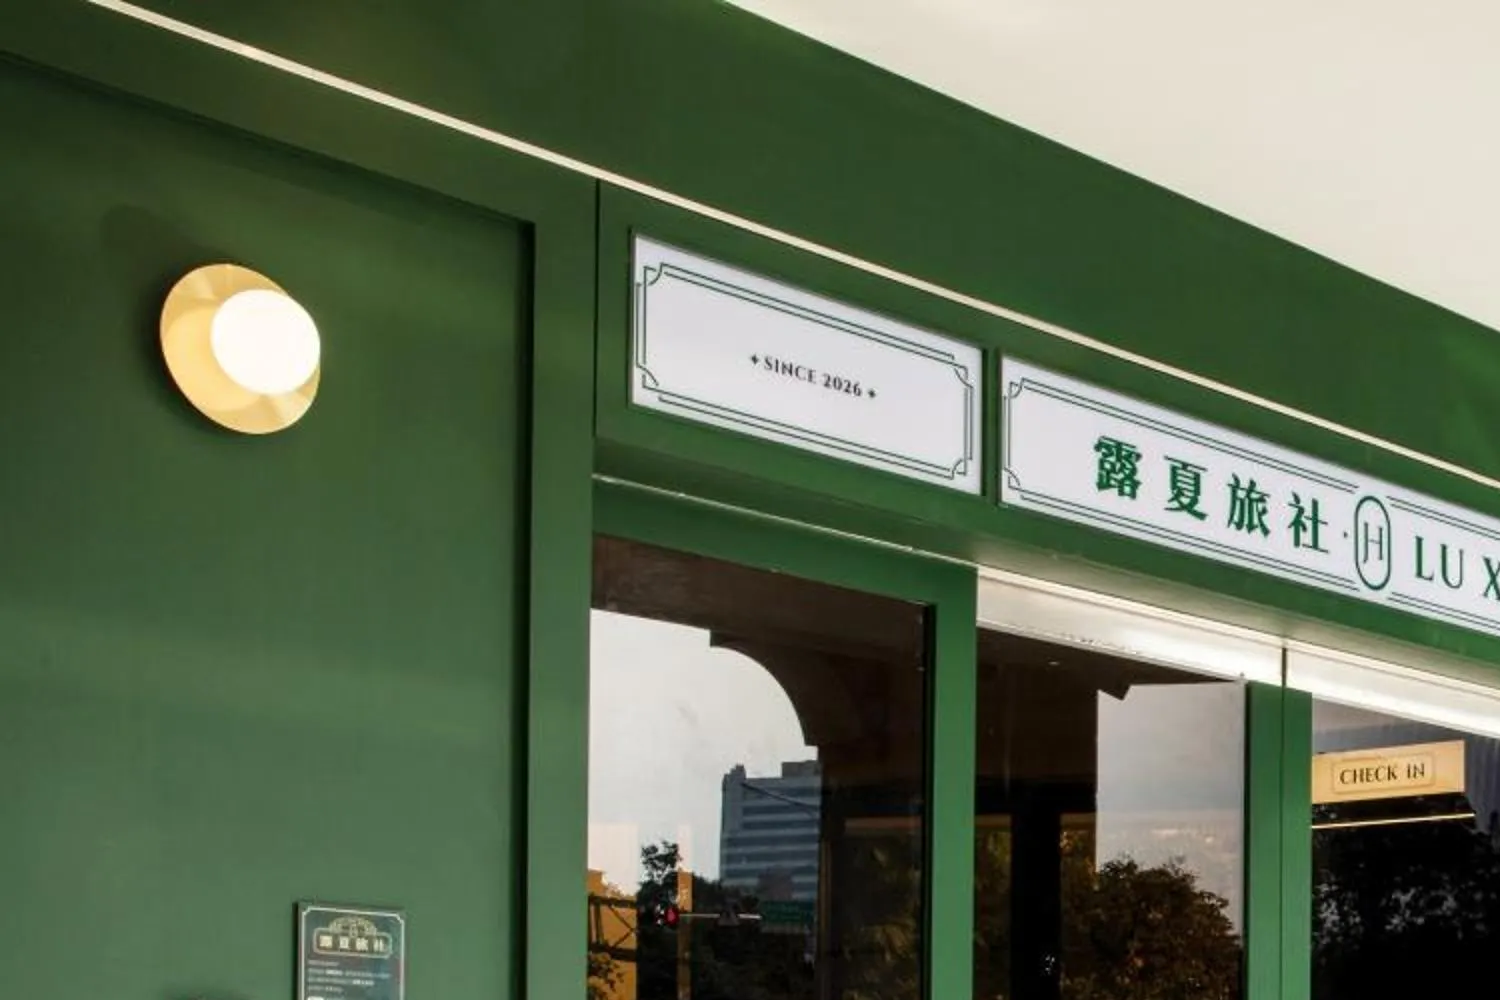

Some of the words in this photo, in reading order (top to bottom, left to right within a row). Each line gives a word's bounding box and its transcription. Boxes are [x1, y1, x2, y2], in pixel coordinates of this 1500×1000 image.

[764, 355, 817, 384] SINCE
[822, 372, 862, 397] 2026
[1093, 435, 1329, 554] 露夏旅社
[1414, 535, 1464, 590] LU
[1340, 764, 1398, 785] CHECK
[1406, 762, 1425, 780] IN
